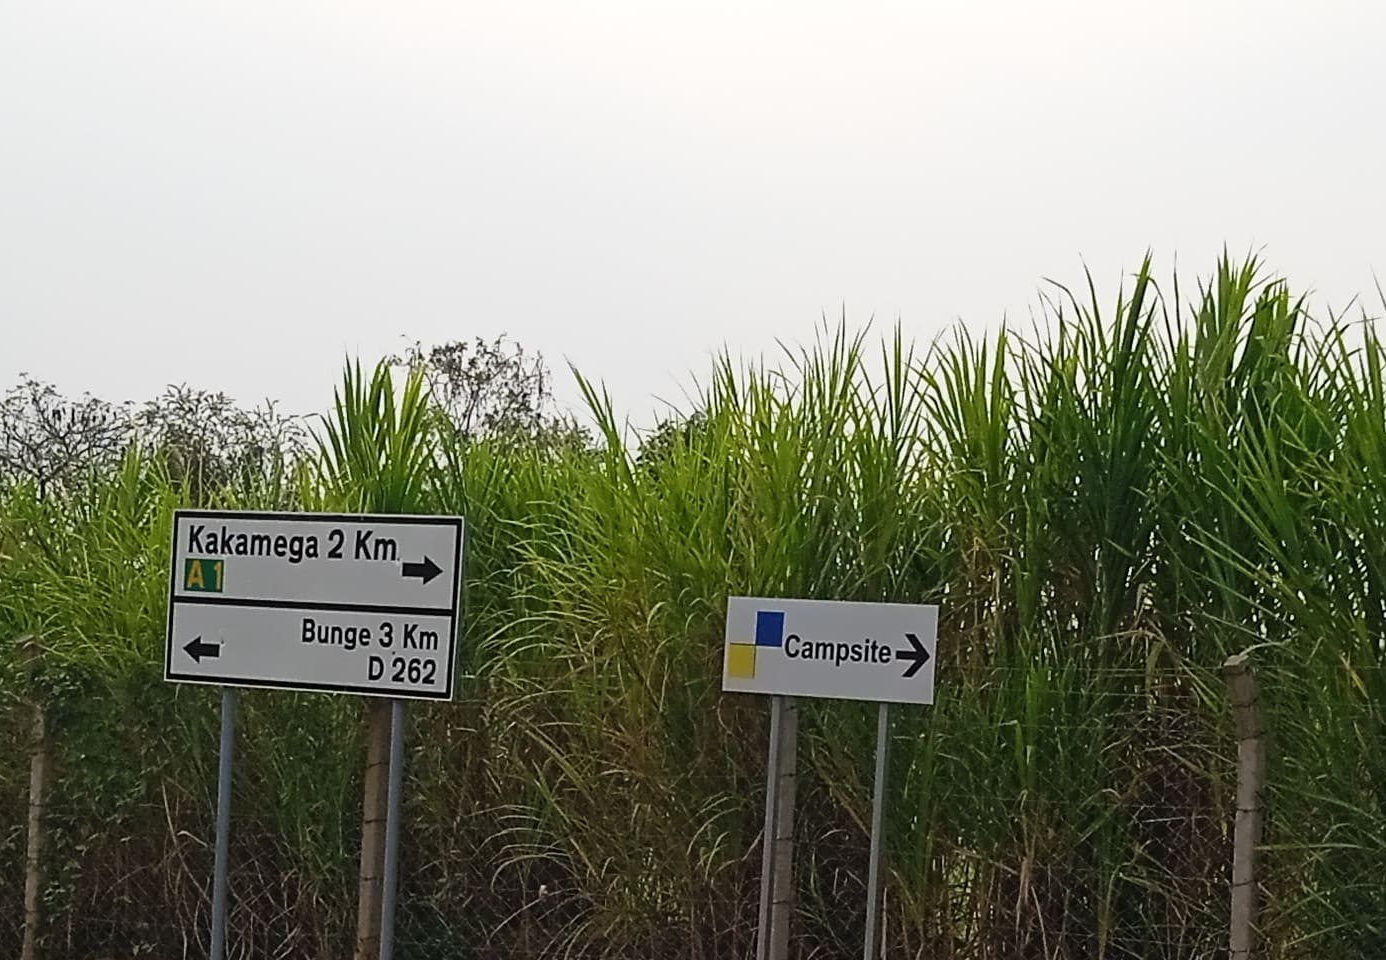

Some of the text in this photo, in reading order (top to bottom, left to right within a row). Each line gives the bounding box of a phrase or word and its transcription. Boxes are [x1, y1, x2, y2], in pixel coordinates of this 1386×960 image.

[188, 525, 397, 563] Kakamega 2 Km
[302, 618, 438, 650] Bunge 3 Km
[785, 635, 891, 666] Campsite
[368, 656, 436, 684] D 262
